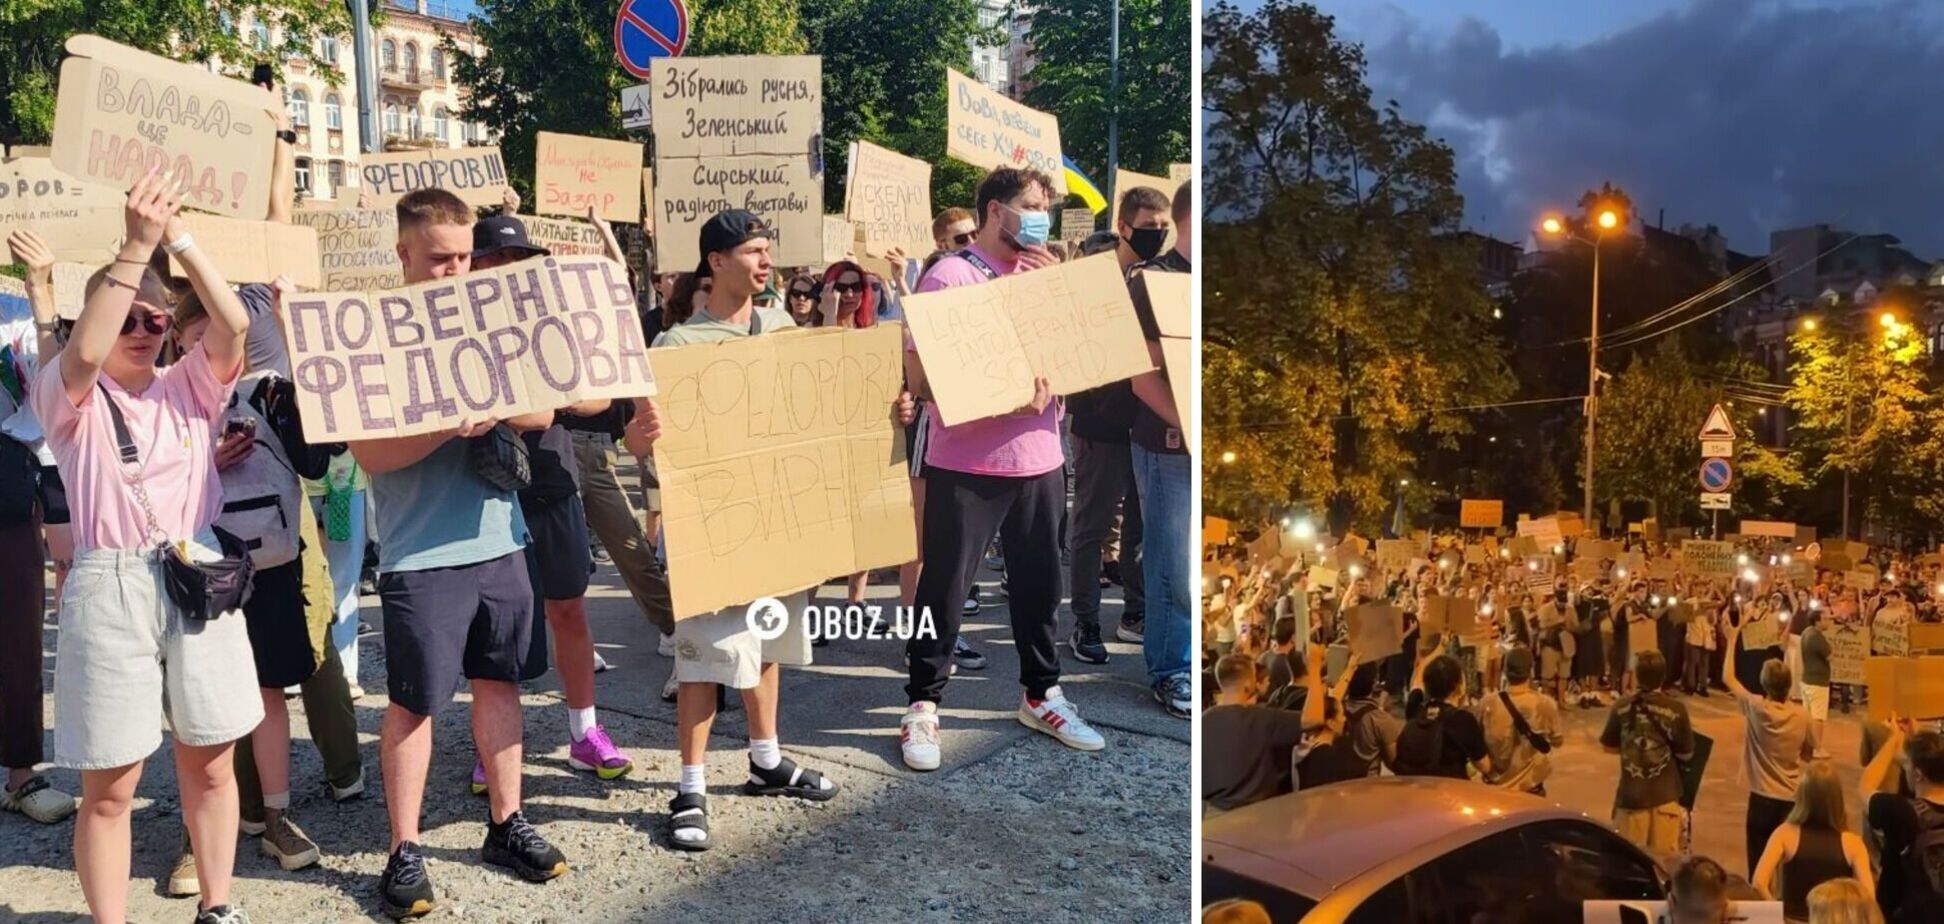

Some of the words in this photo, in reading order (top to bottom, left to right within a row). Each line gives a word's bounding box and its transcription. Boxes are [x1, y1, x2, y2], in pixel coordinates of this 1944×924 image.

[663, 67, 748, 103] Зібрались
[761, 77, 815, 103] русня,
[137, 120, 168, 146] ЦЕ
[681, 108, 788, 139] Зеленський
[731, 140, 736, 155] і
[693, 164, 790, 194] Сирський,
[665, 197, 732, 223] радіють
[744, 190, 808, 215] відставці
[289, 257, 635, 353] ПОВЕРНІТЬ
[299, 309, 655, 434] ФЕДОРОВА
